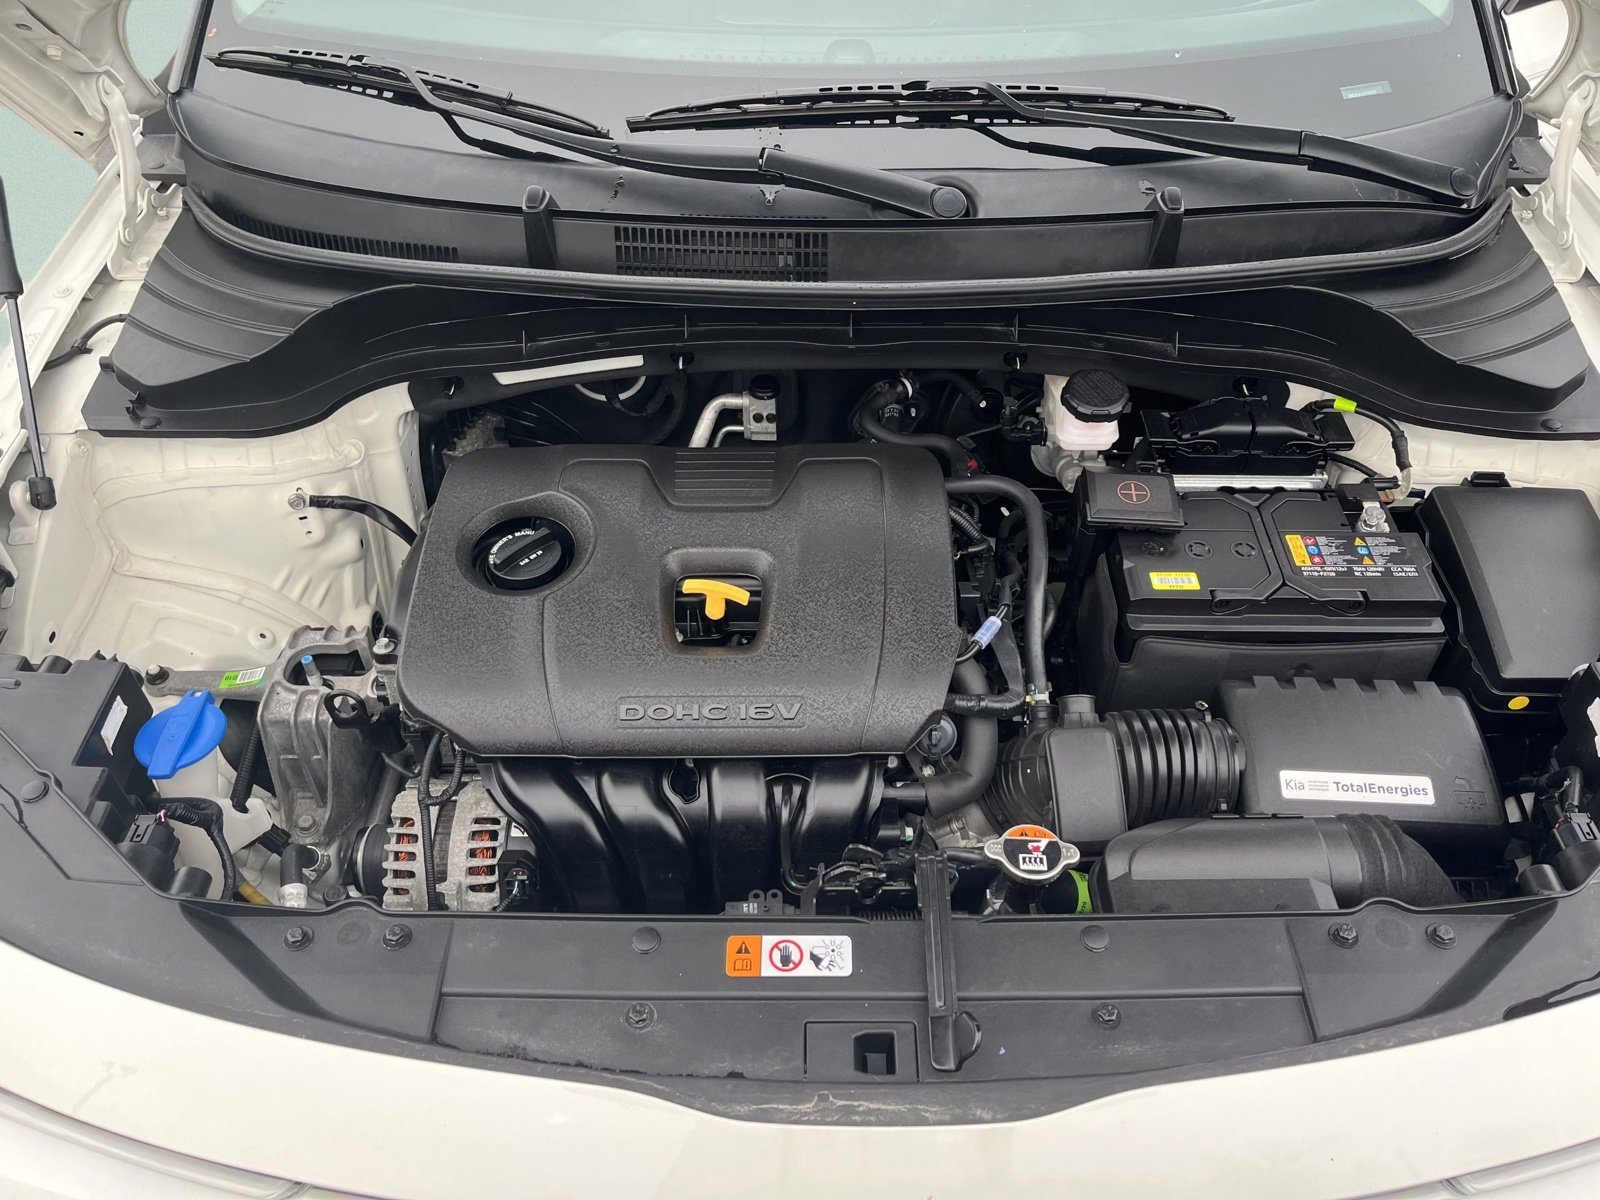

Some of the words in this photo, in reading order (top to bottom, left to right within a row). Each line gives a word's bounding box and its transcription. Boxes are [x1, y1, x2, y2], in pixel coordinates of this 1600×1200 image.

[619, 703, 729, 721] DOHC
[738, 703, 803, 721] 16V
[1284, 778, 1306, 791] Kia
[1333, 781, 1429, 797] TotalEnergies
